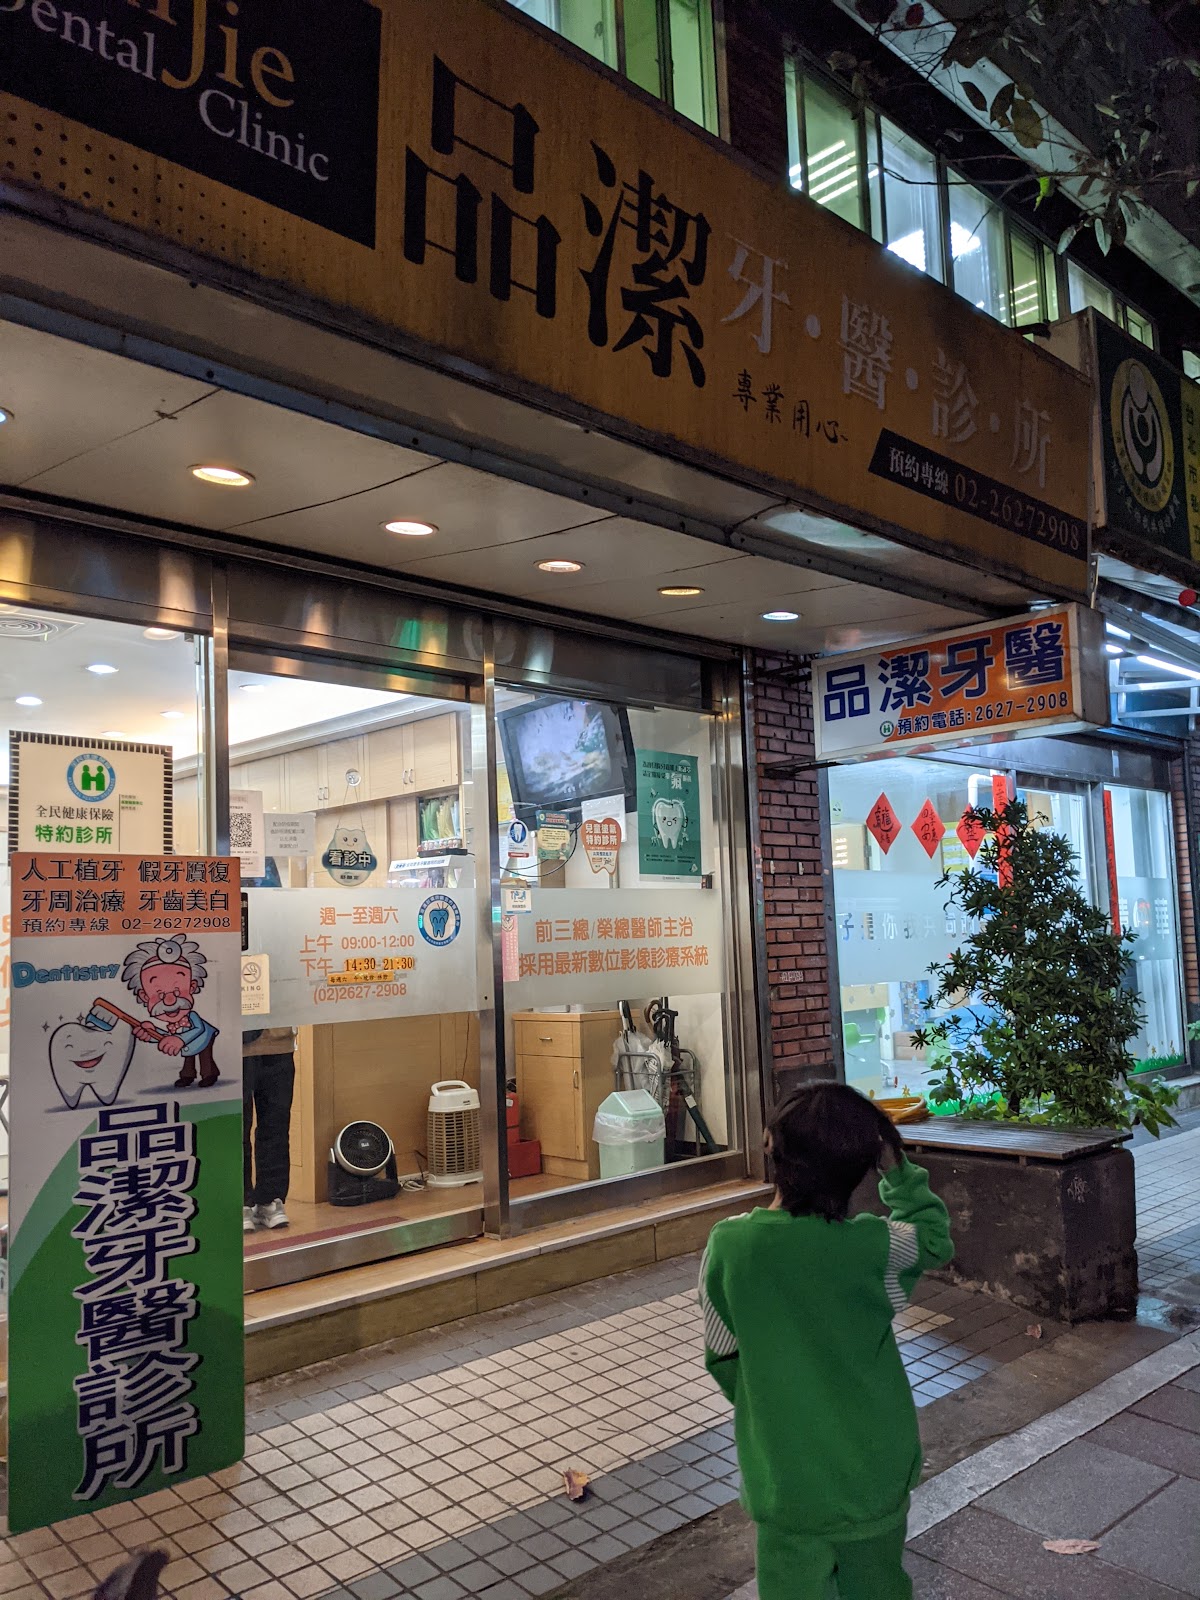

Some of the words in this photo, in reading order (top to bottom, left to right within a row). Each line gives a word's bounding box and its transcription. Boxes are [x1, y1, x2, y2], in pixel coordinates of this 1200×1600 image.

[199, 89, 329, 181] Clinic
[732, 368, 848, 444] 專業用心
[888, 446, 949, 494] 預約專線
[954, 471, 1080, 551] 02-26272908
[824, 620, 1065, 722] 品潔牙醫
[36, 804, 114, 821] 全民健康保險
[35, 824, 113, 844] 特約診所
[329, 849, 371, 868] 看診中
[21, 858, 125, 883] 人工植牙
[21, 889, 125, 912] 牙周治療
[138, 889, 229, 912] 牙齒美白
[22, 917, 110, 933] 預約專線
[121, 917, 231, 930] 02-26272908
[320, 906, 399, 925] 週一至週六
[300, 935, 333, 953] 上午
[341, 935, 415, 950] 09:00-12:00
[300, 957, 333, 977] 下午
[518, 945, 709, 978] 採用最新數位影像診療系統
[11, 961, 121, 988] Dentistry
[313, 983, 407, 1004] (02)2627-2908
[72, 1101, 199, 1500] 品潔牙醫診所
